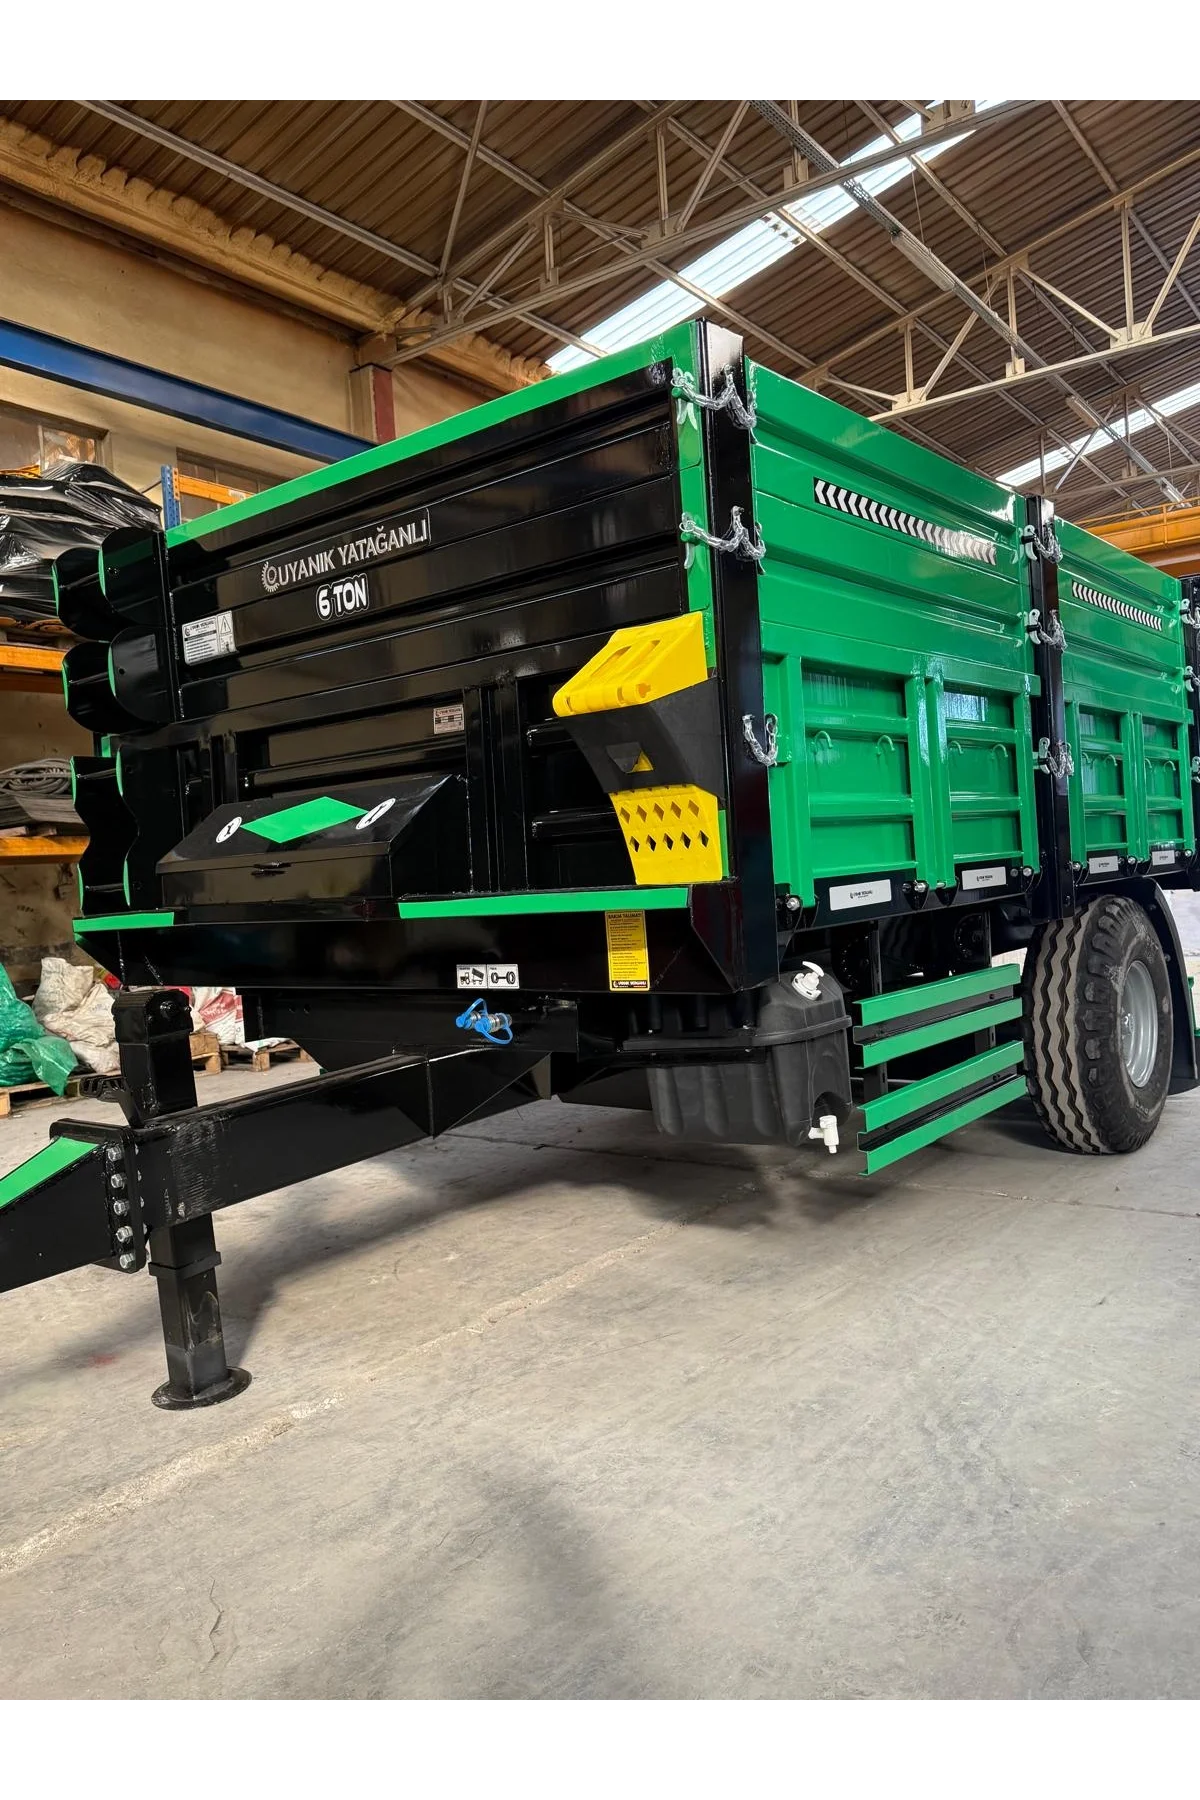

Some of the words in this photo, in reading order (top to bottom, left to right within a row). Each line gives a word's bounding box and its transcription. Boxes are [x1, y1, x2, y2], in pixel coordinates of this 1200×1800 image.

[278, 549, 336, 586] UYANIK
[338, 519, 428, 566] YATAĞANLI
[318, 588, 331, 617] 6
[332, 577, 367, 613] TON
